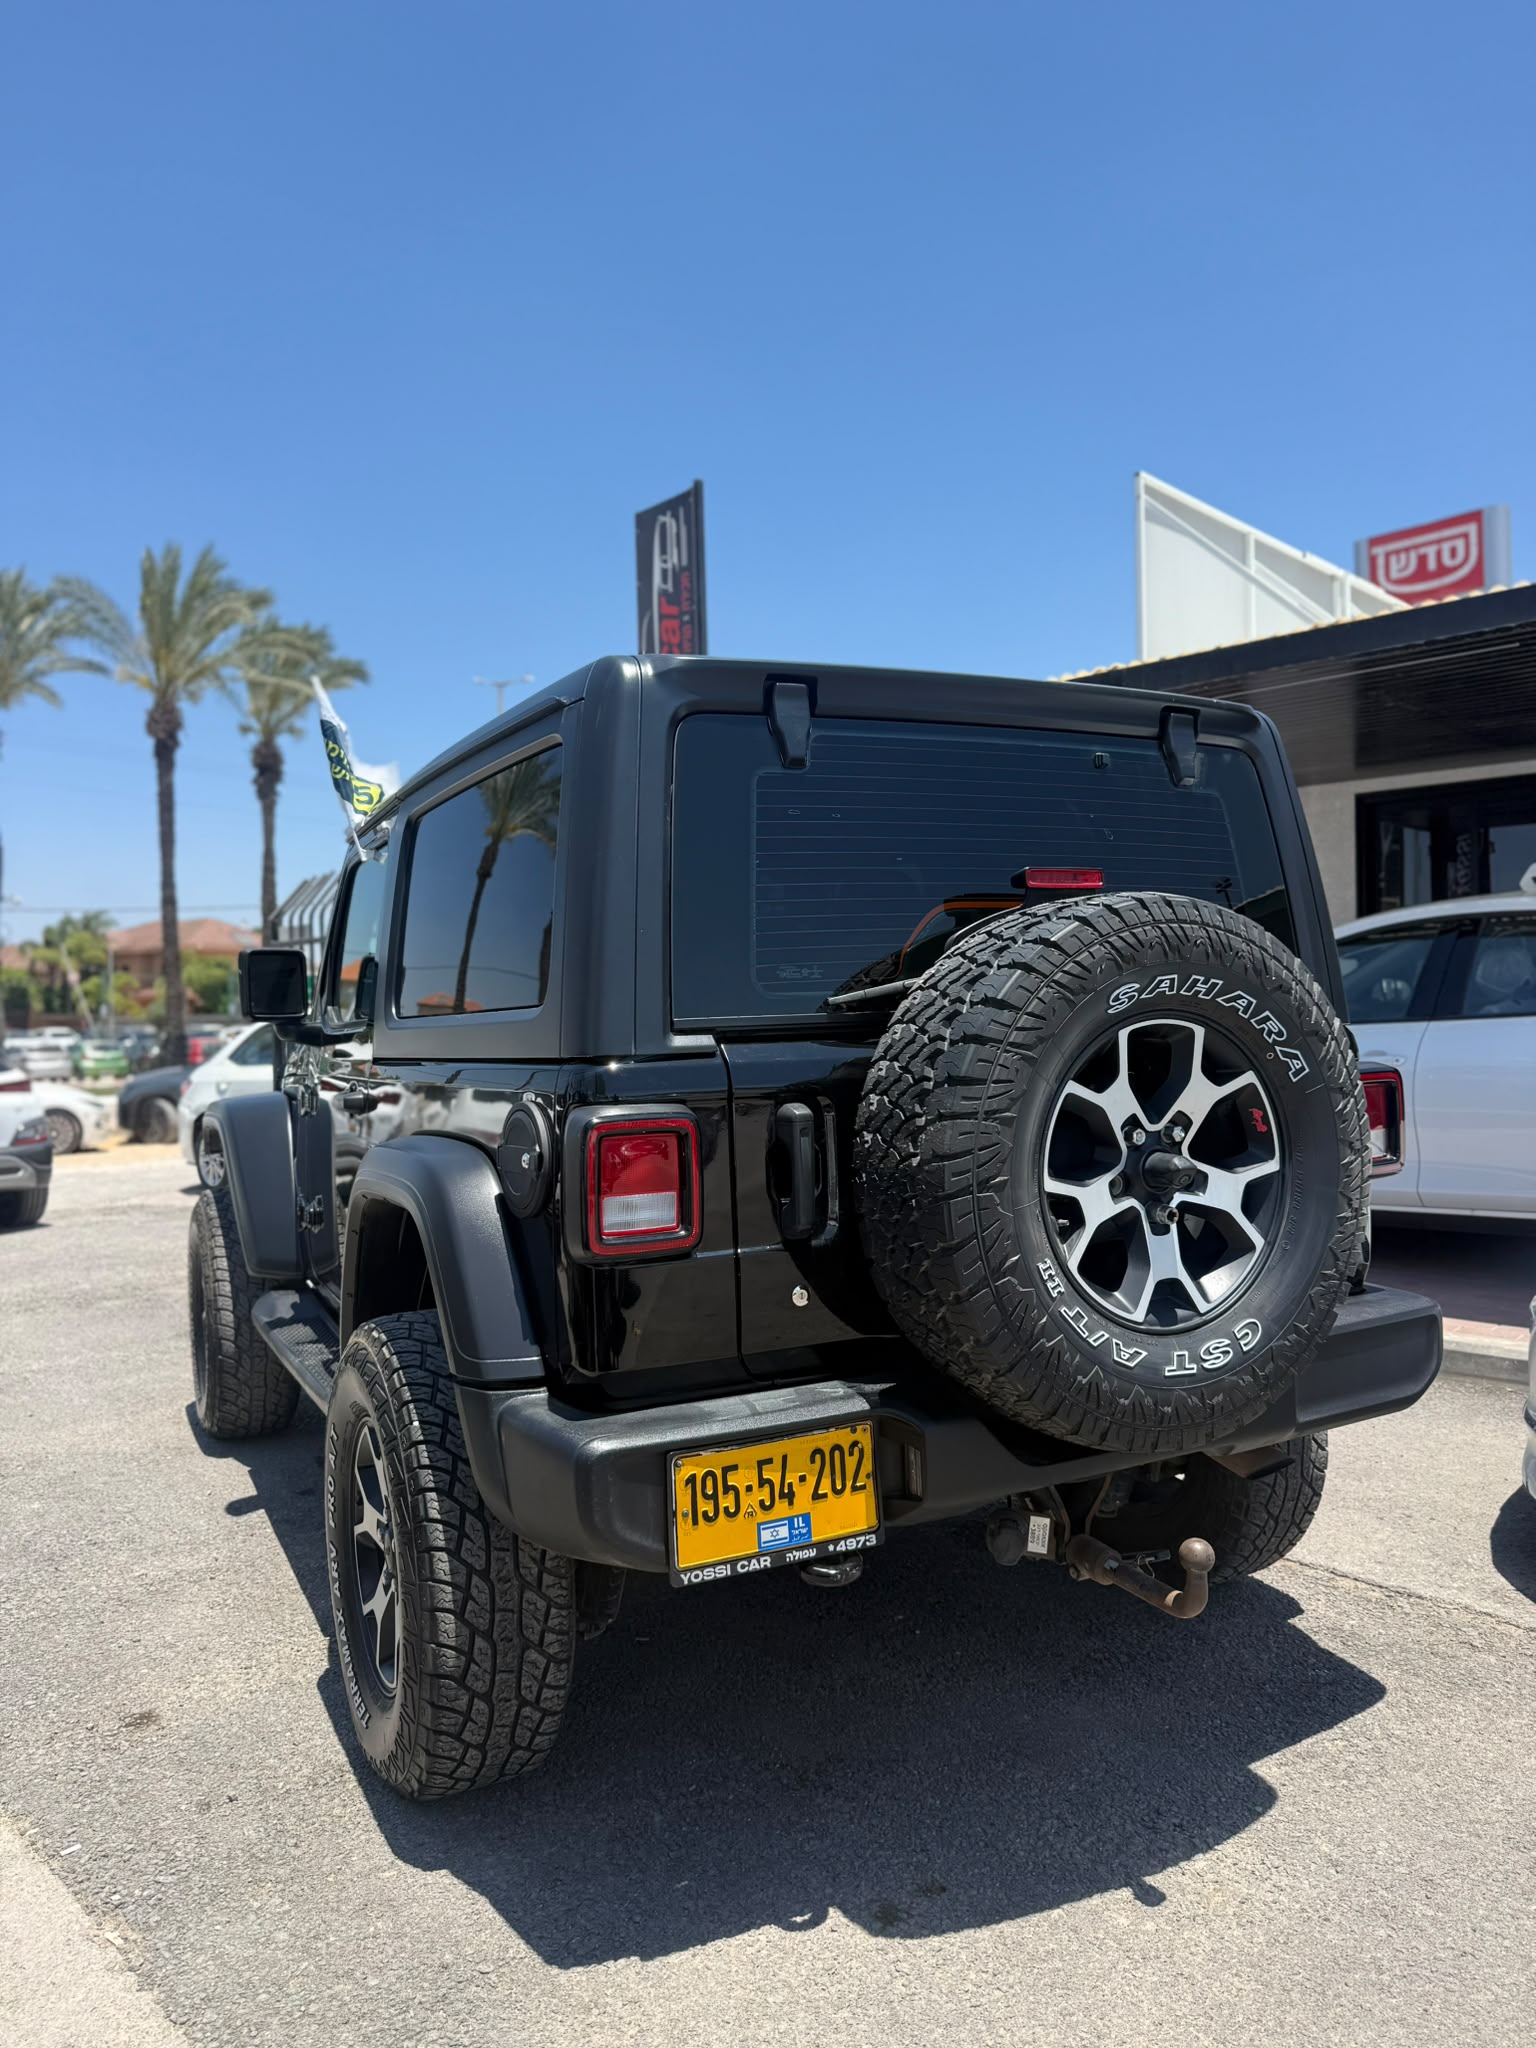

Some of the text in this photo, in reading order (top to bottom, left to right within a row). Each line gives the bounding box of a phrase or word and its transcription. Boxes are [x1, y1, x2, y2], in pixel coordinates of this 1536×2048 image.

[1106, 973, 1310, 1083] SAHARA
[1164, 1318, 1262, 1377] CST
[794, 1516, 806, 1529] IL
[327, 1423, 371, 1729] TERRAMAX ARV PRO A/T
[680, 1566, 731, 1585] YOSSI
[737, 1556, 772, 1574] CAR
[785, 1548, 817, 1563] עפולה
